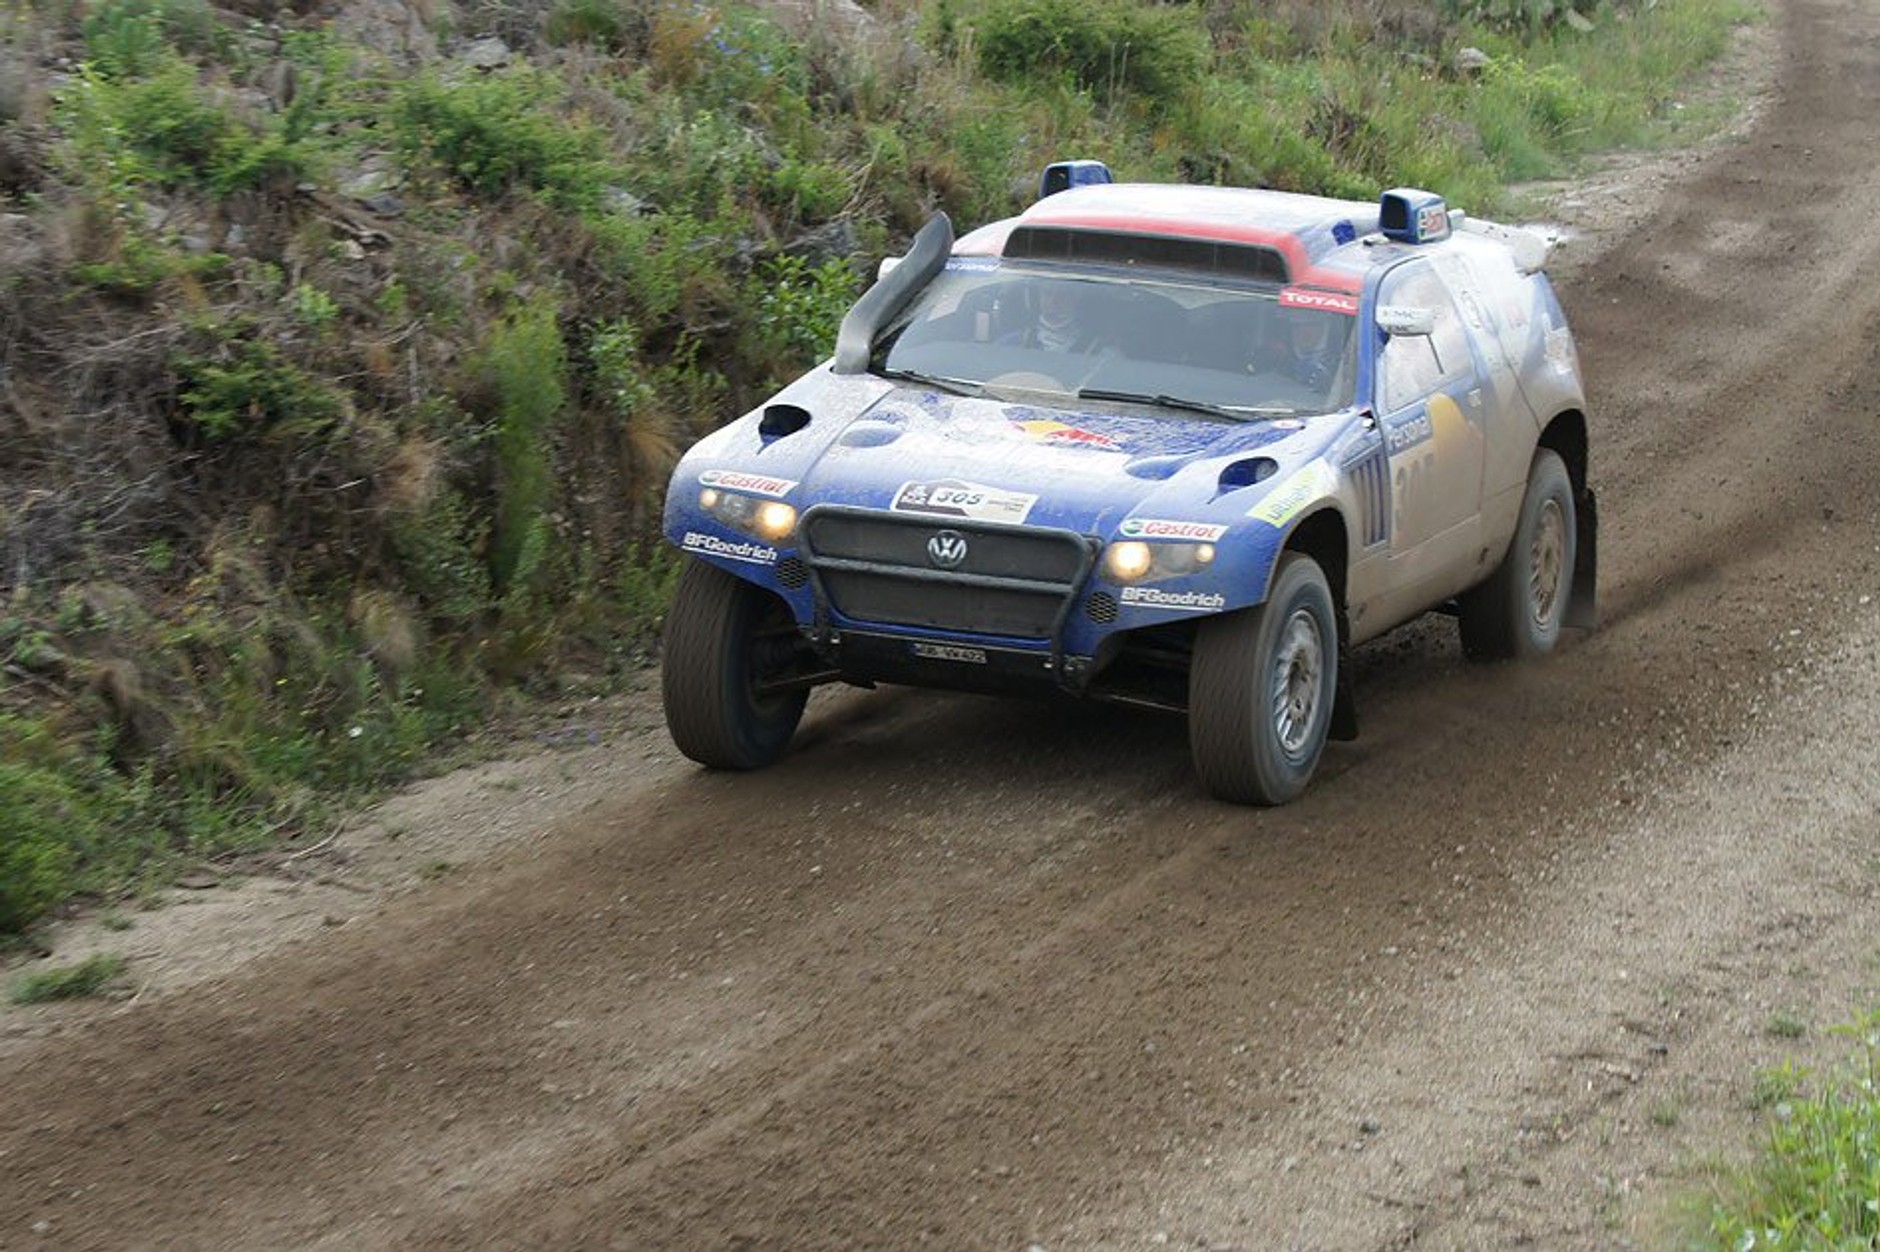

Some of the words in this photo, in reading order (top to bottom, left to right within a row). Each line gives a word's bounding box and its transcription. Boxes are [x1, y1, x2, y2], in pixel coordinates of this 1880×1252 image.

[1283, 292, 1356, 310] TOTAL
[720, 473, 789, 493] Castrol
[936, 490, 985, 505] 305
[1145, 522, 1218, 538] Castrol
[683, 532, 777, 561] BFGoodrich
[1121, 587, 1224, 607] BFGoodrich
